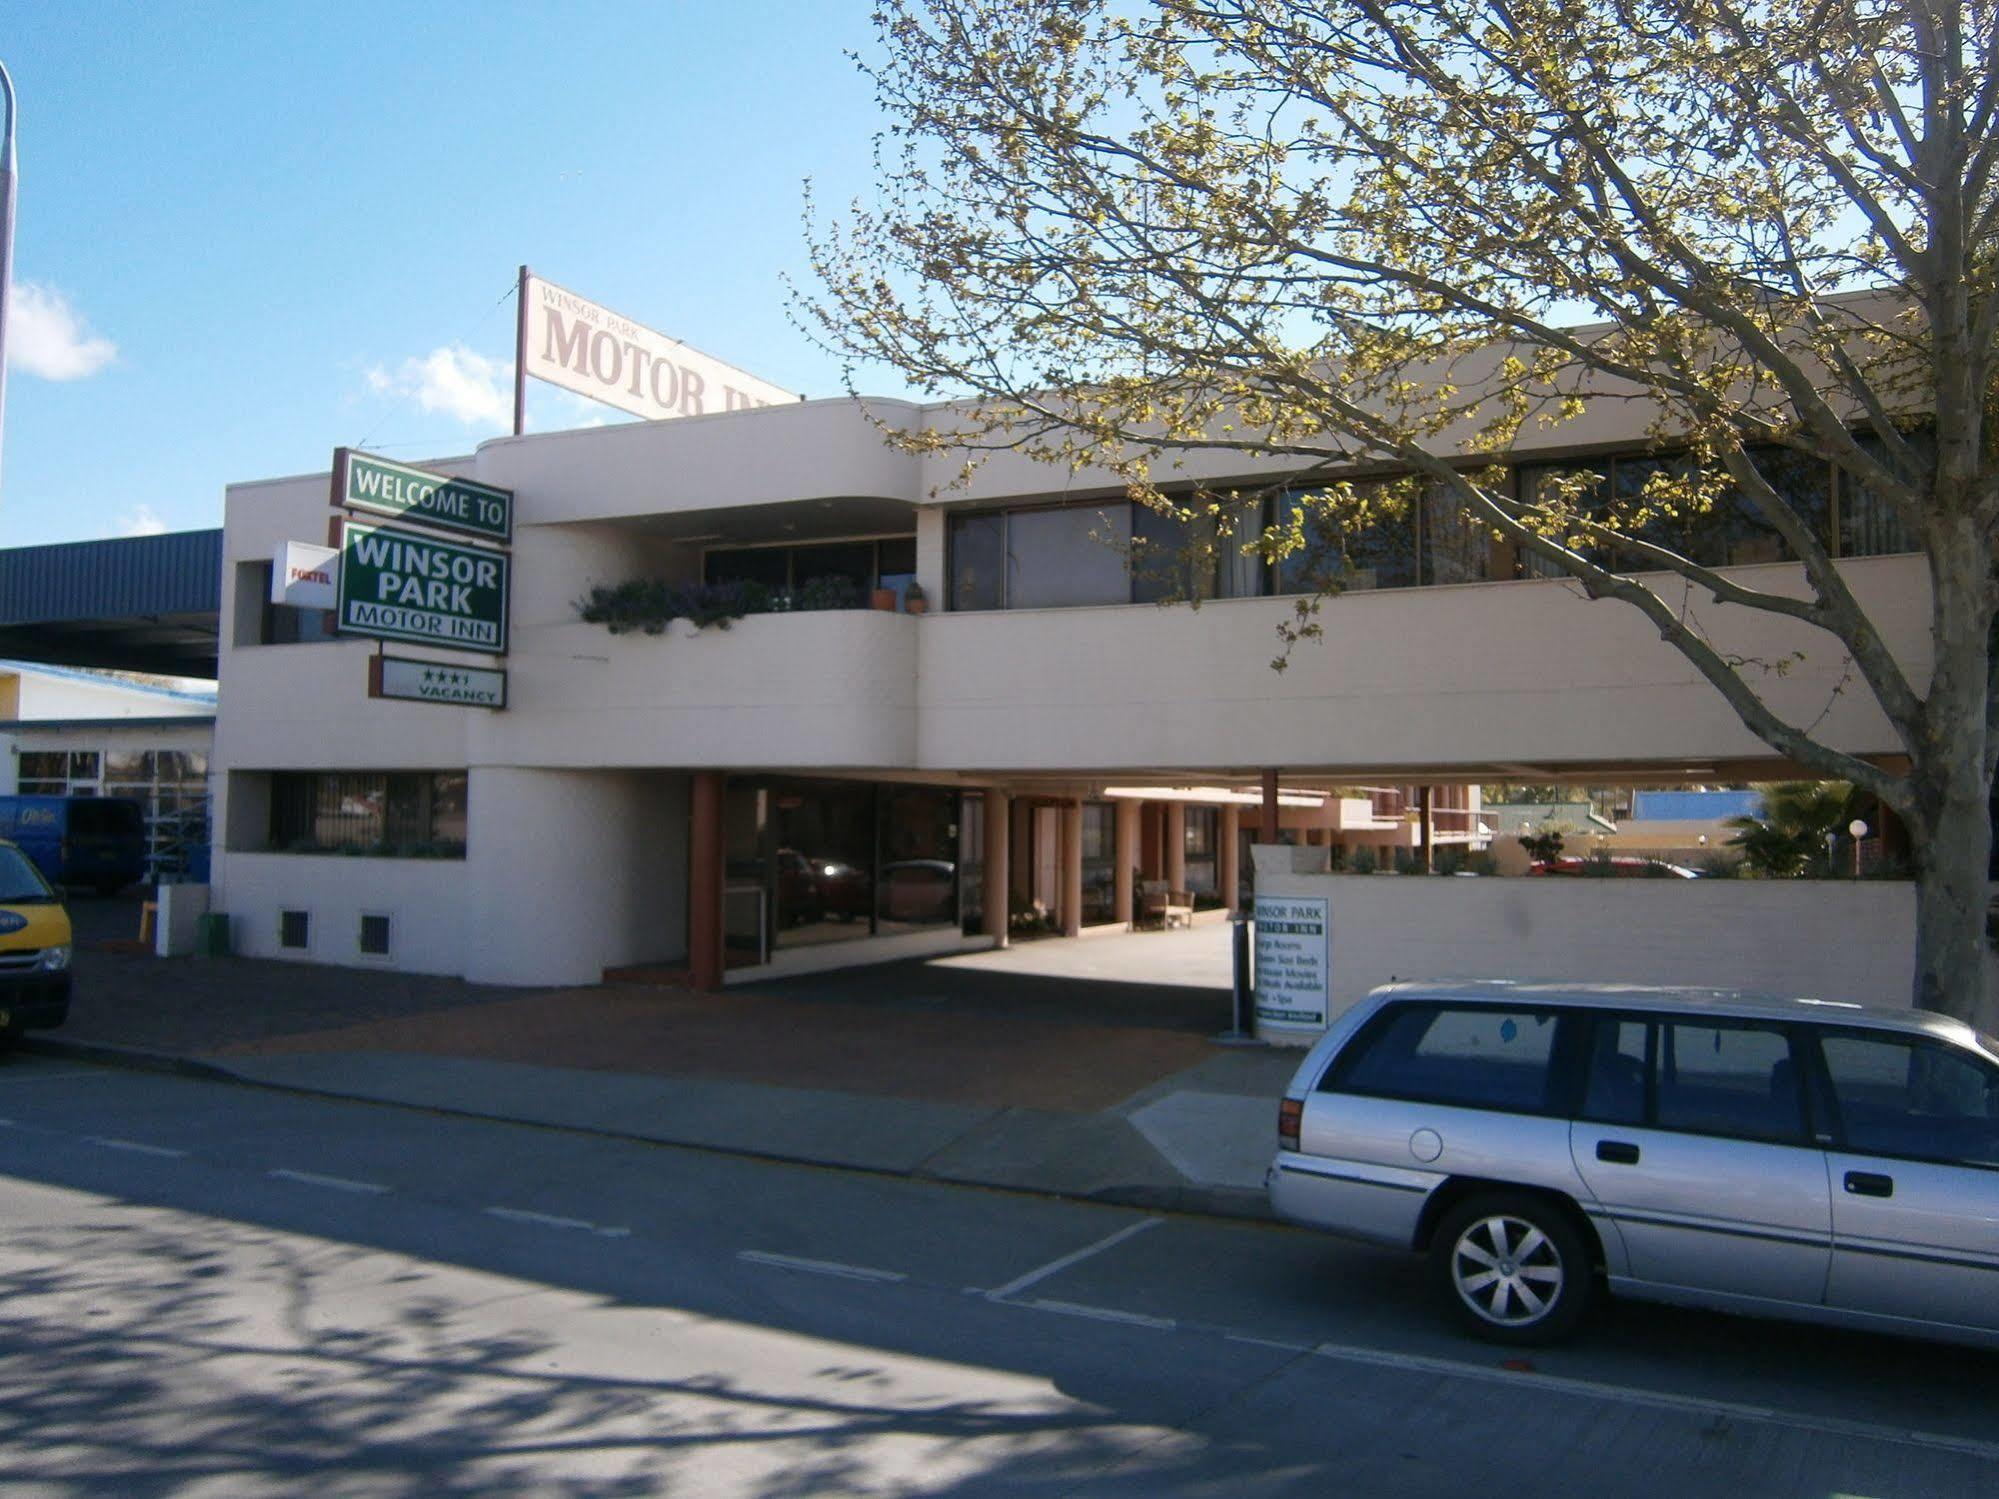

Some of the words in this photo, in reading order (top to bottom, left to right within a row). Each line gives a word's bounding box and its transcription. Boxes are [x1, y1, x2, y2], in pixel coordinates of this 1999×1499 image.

[543, 286, 600, 323] WINSOR
[607, 316, 640, 342] PARK
[541, 304, 705, 416] MOTOR
[356, 467, 470, 518] WELCOME
[476, 498, 502, 525] TO
[353, 533, 497, 589] WINSOR
[378, 571, 473, 614] PARK
[356, 604, 442, 632] MOTOR
[451, 620, 493, 641] INN
[418, 684, 496, 702] VACANCY
[1256, 904, 1287, 919] INSOR
[1291, 906, 1322, 920] PARK
